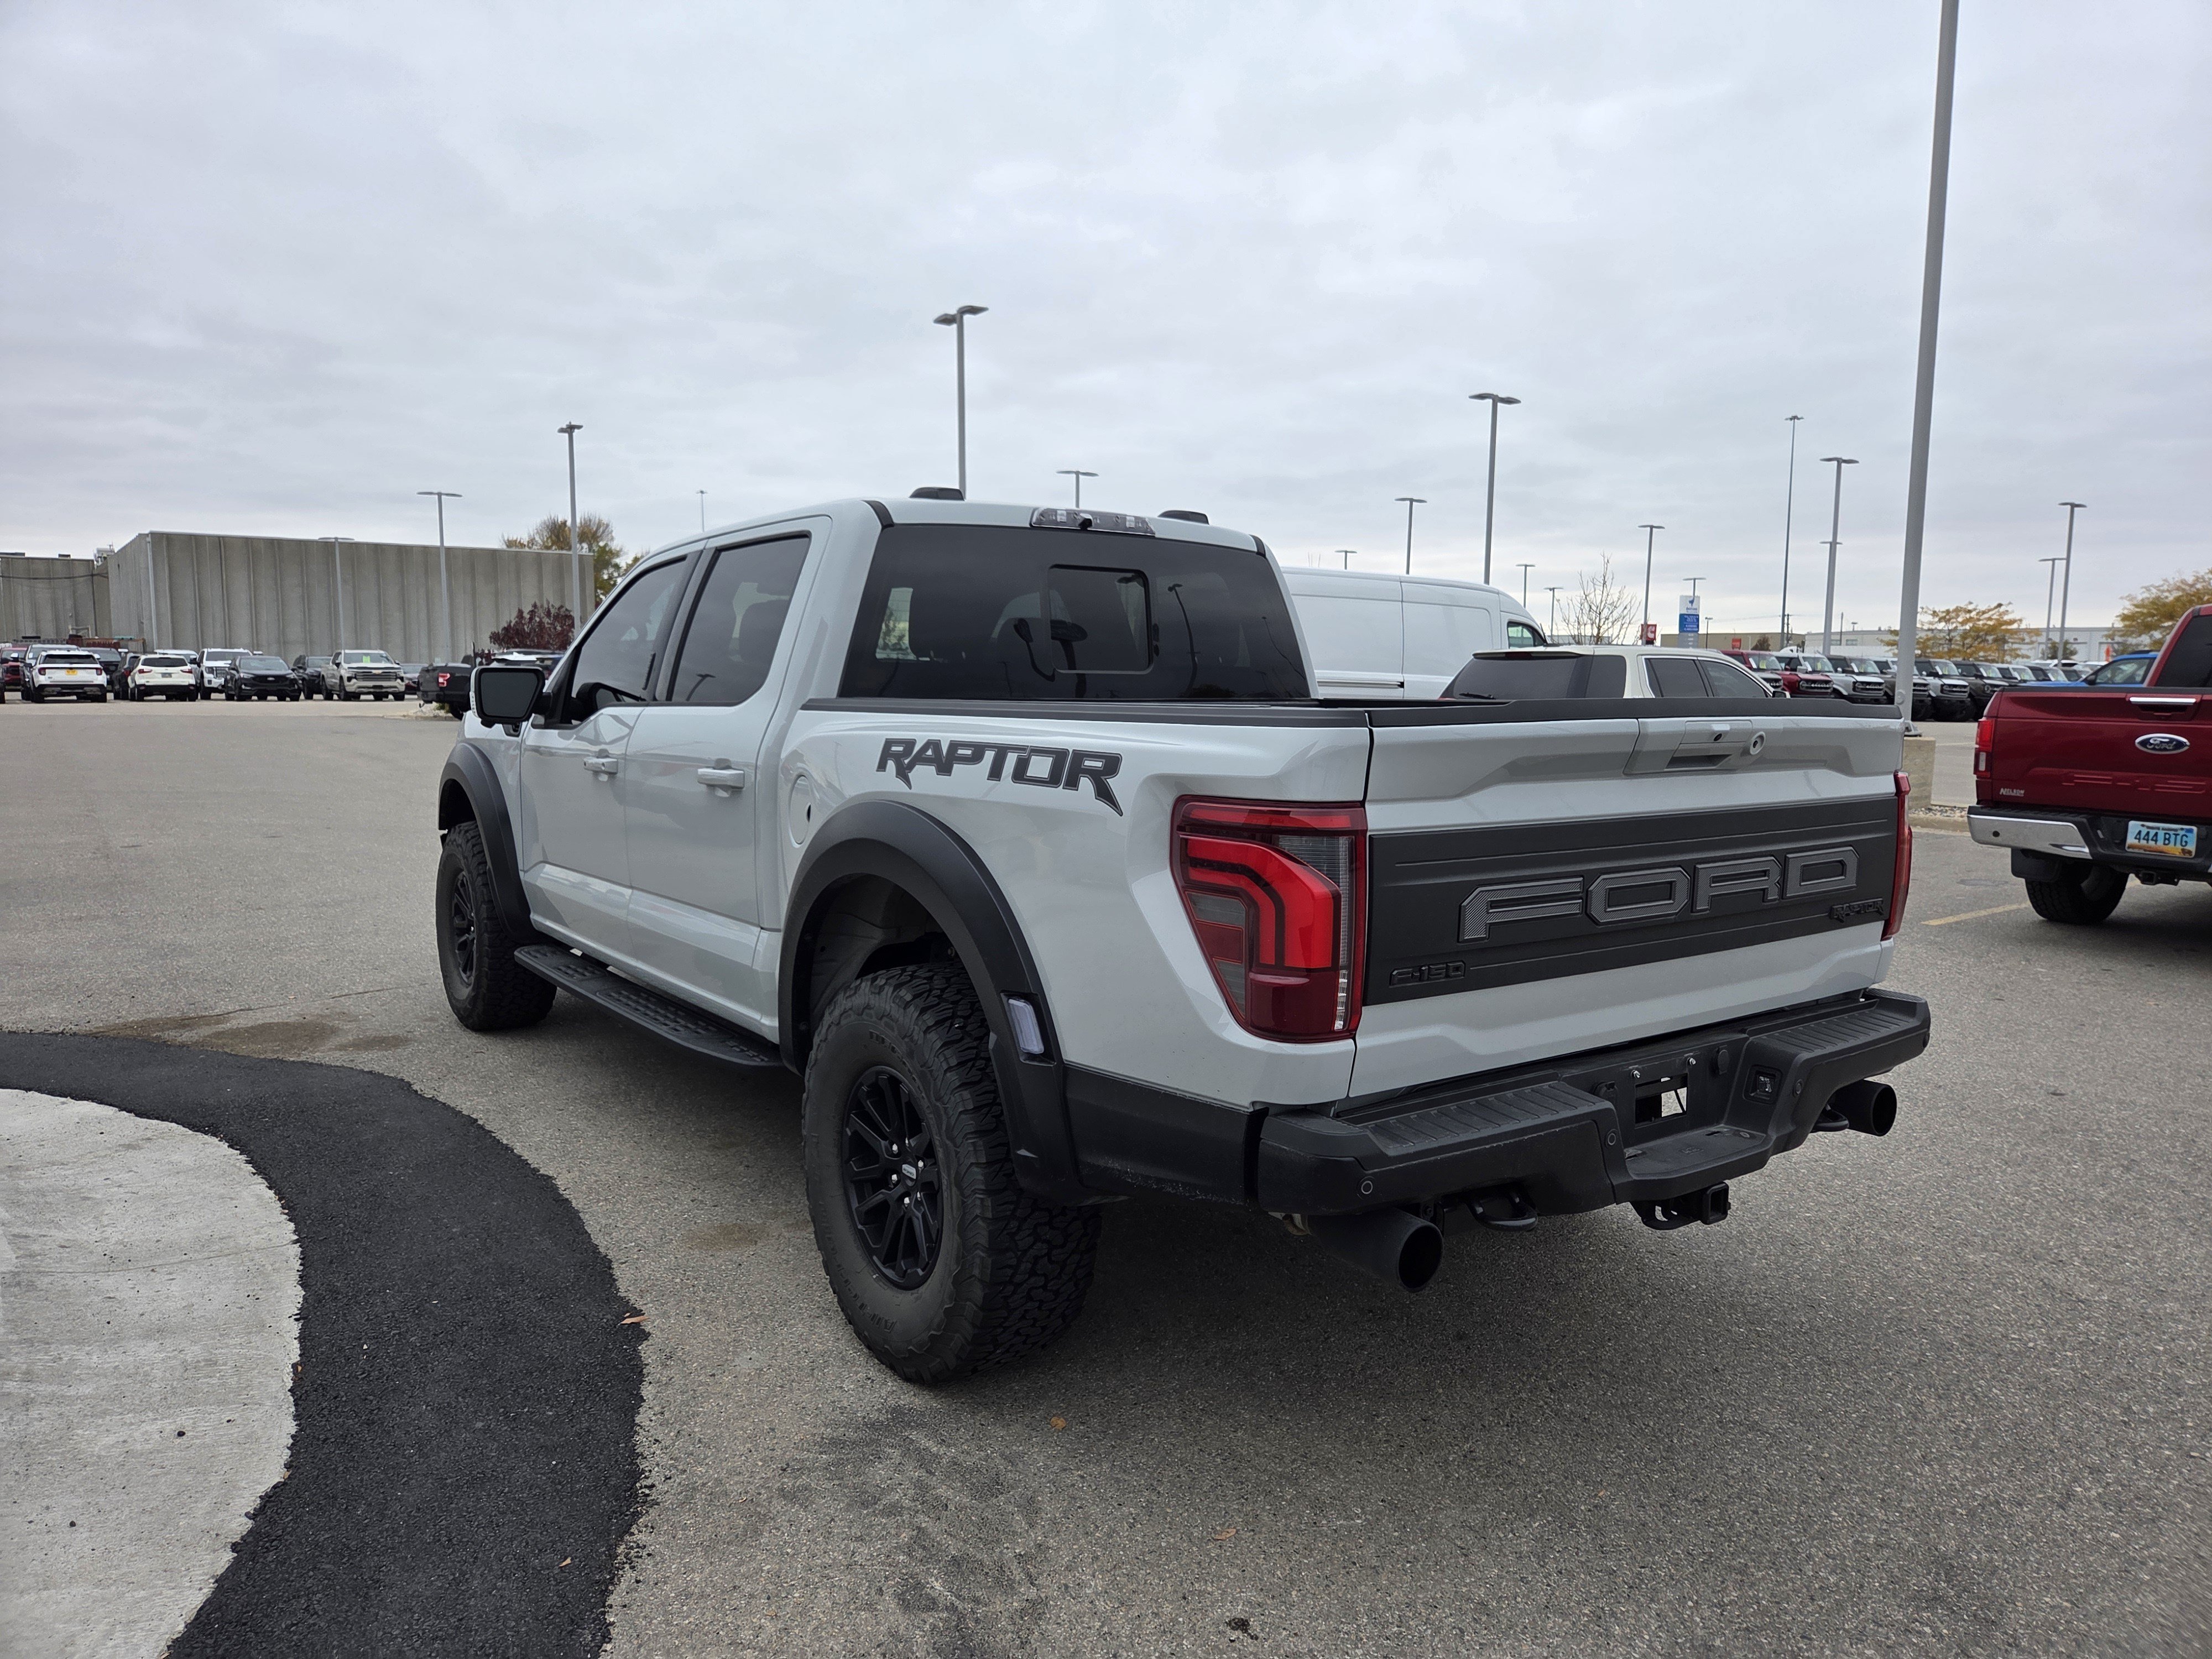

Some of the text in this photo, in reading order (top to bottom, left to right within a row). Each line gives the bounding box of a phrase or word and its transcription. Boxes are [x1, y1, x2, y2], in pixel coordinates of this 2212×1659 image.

[2146, 737, 2177, 750] Ford
[876, 738, 1123, 817] RAPTOR
[2133, 830, 2188, 847] 444 BTG
[1457, 846, 1861, 943] FORD
[1830, 897, 1884, 923] RAPTOR
[1389, 960, 1466, 988] F-150
